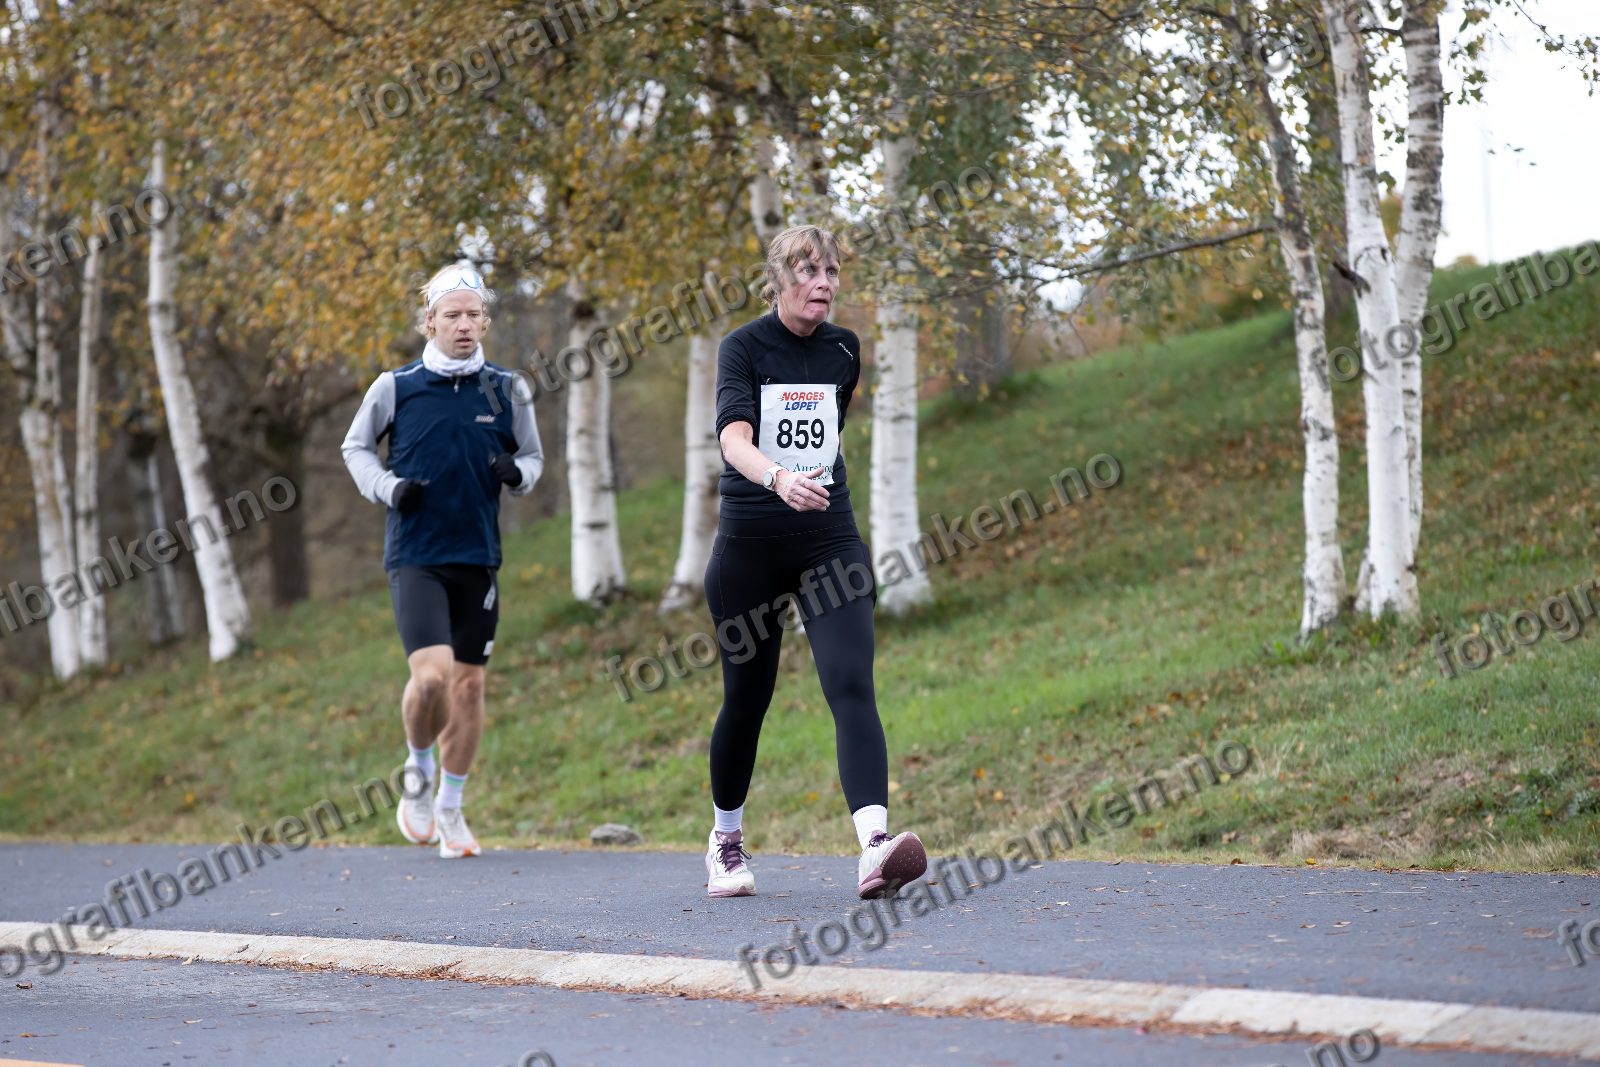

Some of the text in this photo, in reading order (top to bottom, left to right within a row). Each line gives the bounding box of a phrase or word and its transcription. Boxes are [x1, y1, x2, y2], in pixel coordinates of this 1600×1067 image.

[781, 391, 825, 401] NORGES
[785, 401, 819, 411] LØPET
[776, 418, 825, 449] 859
